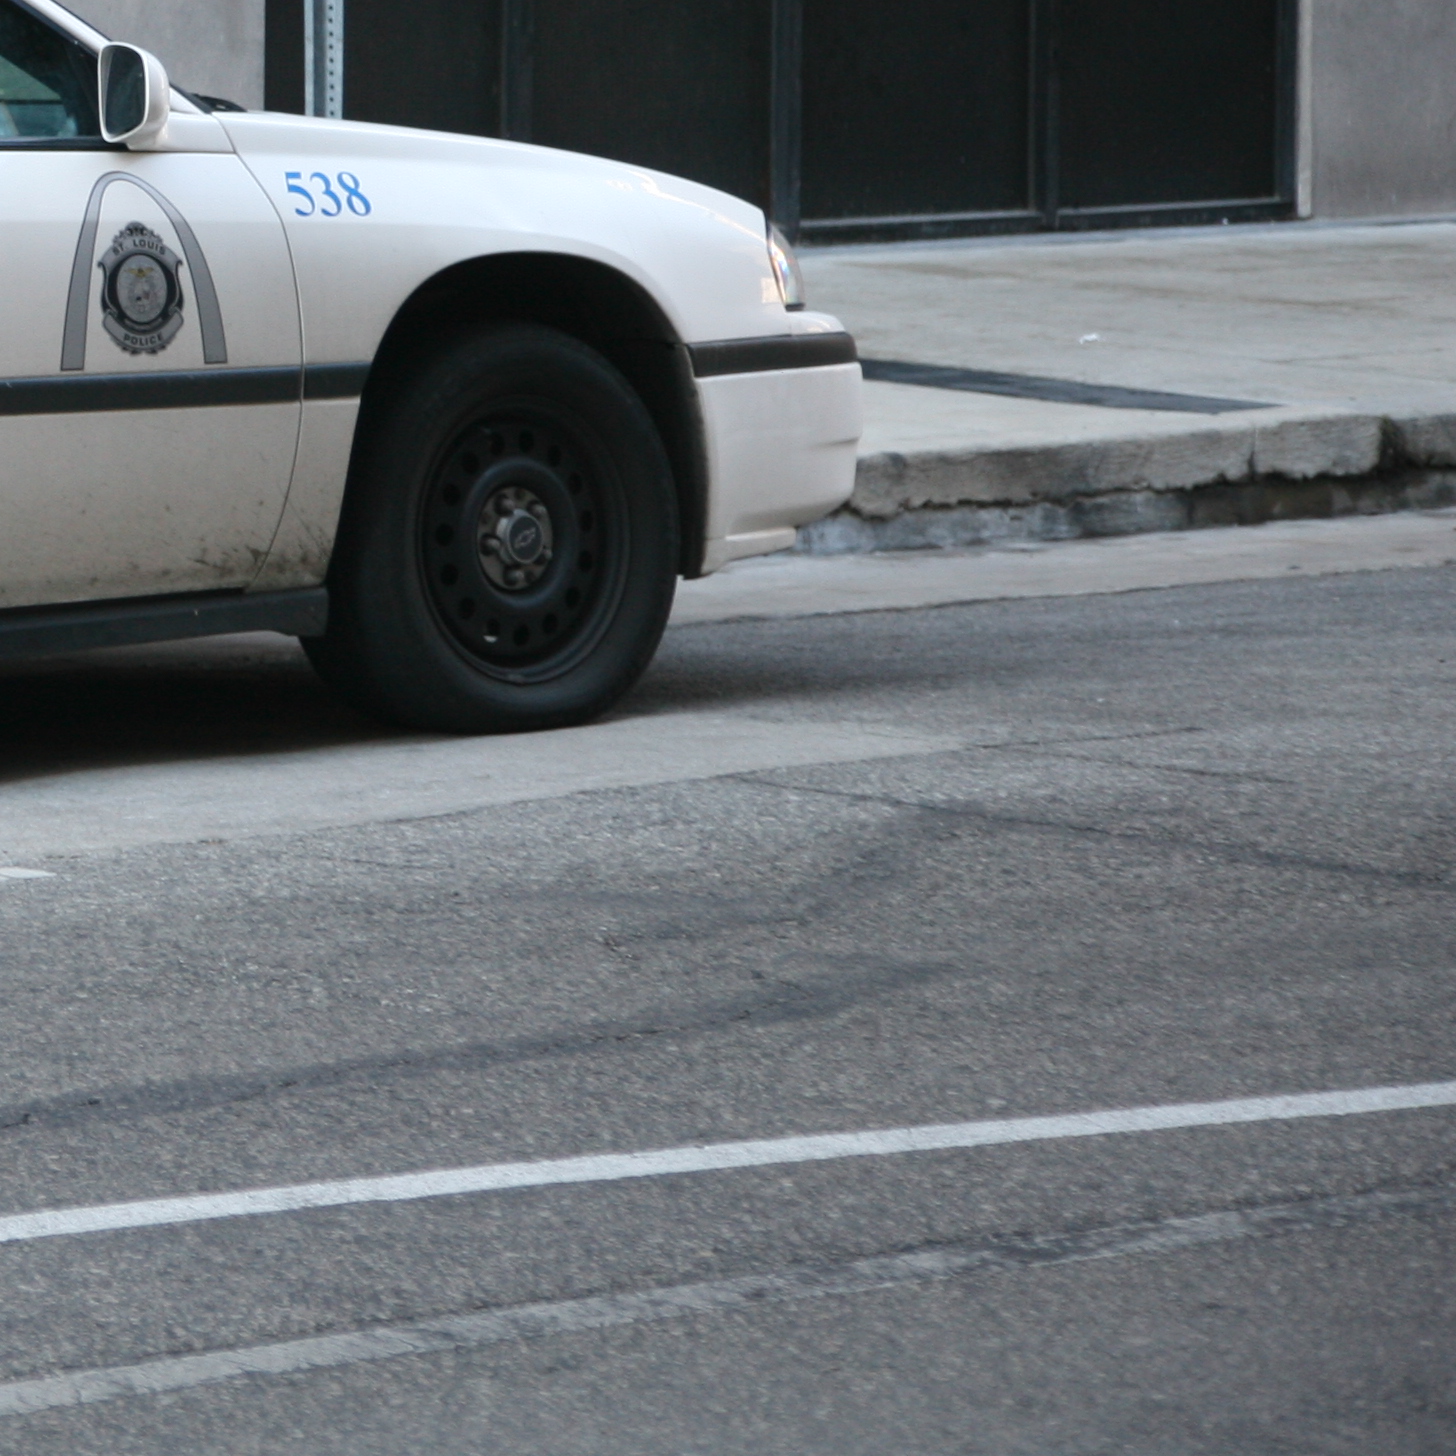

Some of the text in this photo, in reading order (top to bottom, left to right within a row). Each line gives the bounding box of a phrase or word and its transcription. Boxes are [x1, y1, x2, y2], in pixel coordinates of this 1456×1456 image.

[284, 171, 372, 217] 538
[133, 237, 166, 256] LOUIS
[123, 332, 163, 347] POLICE
